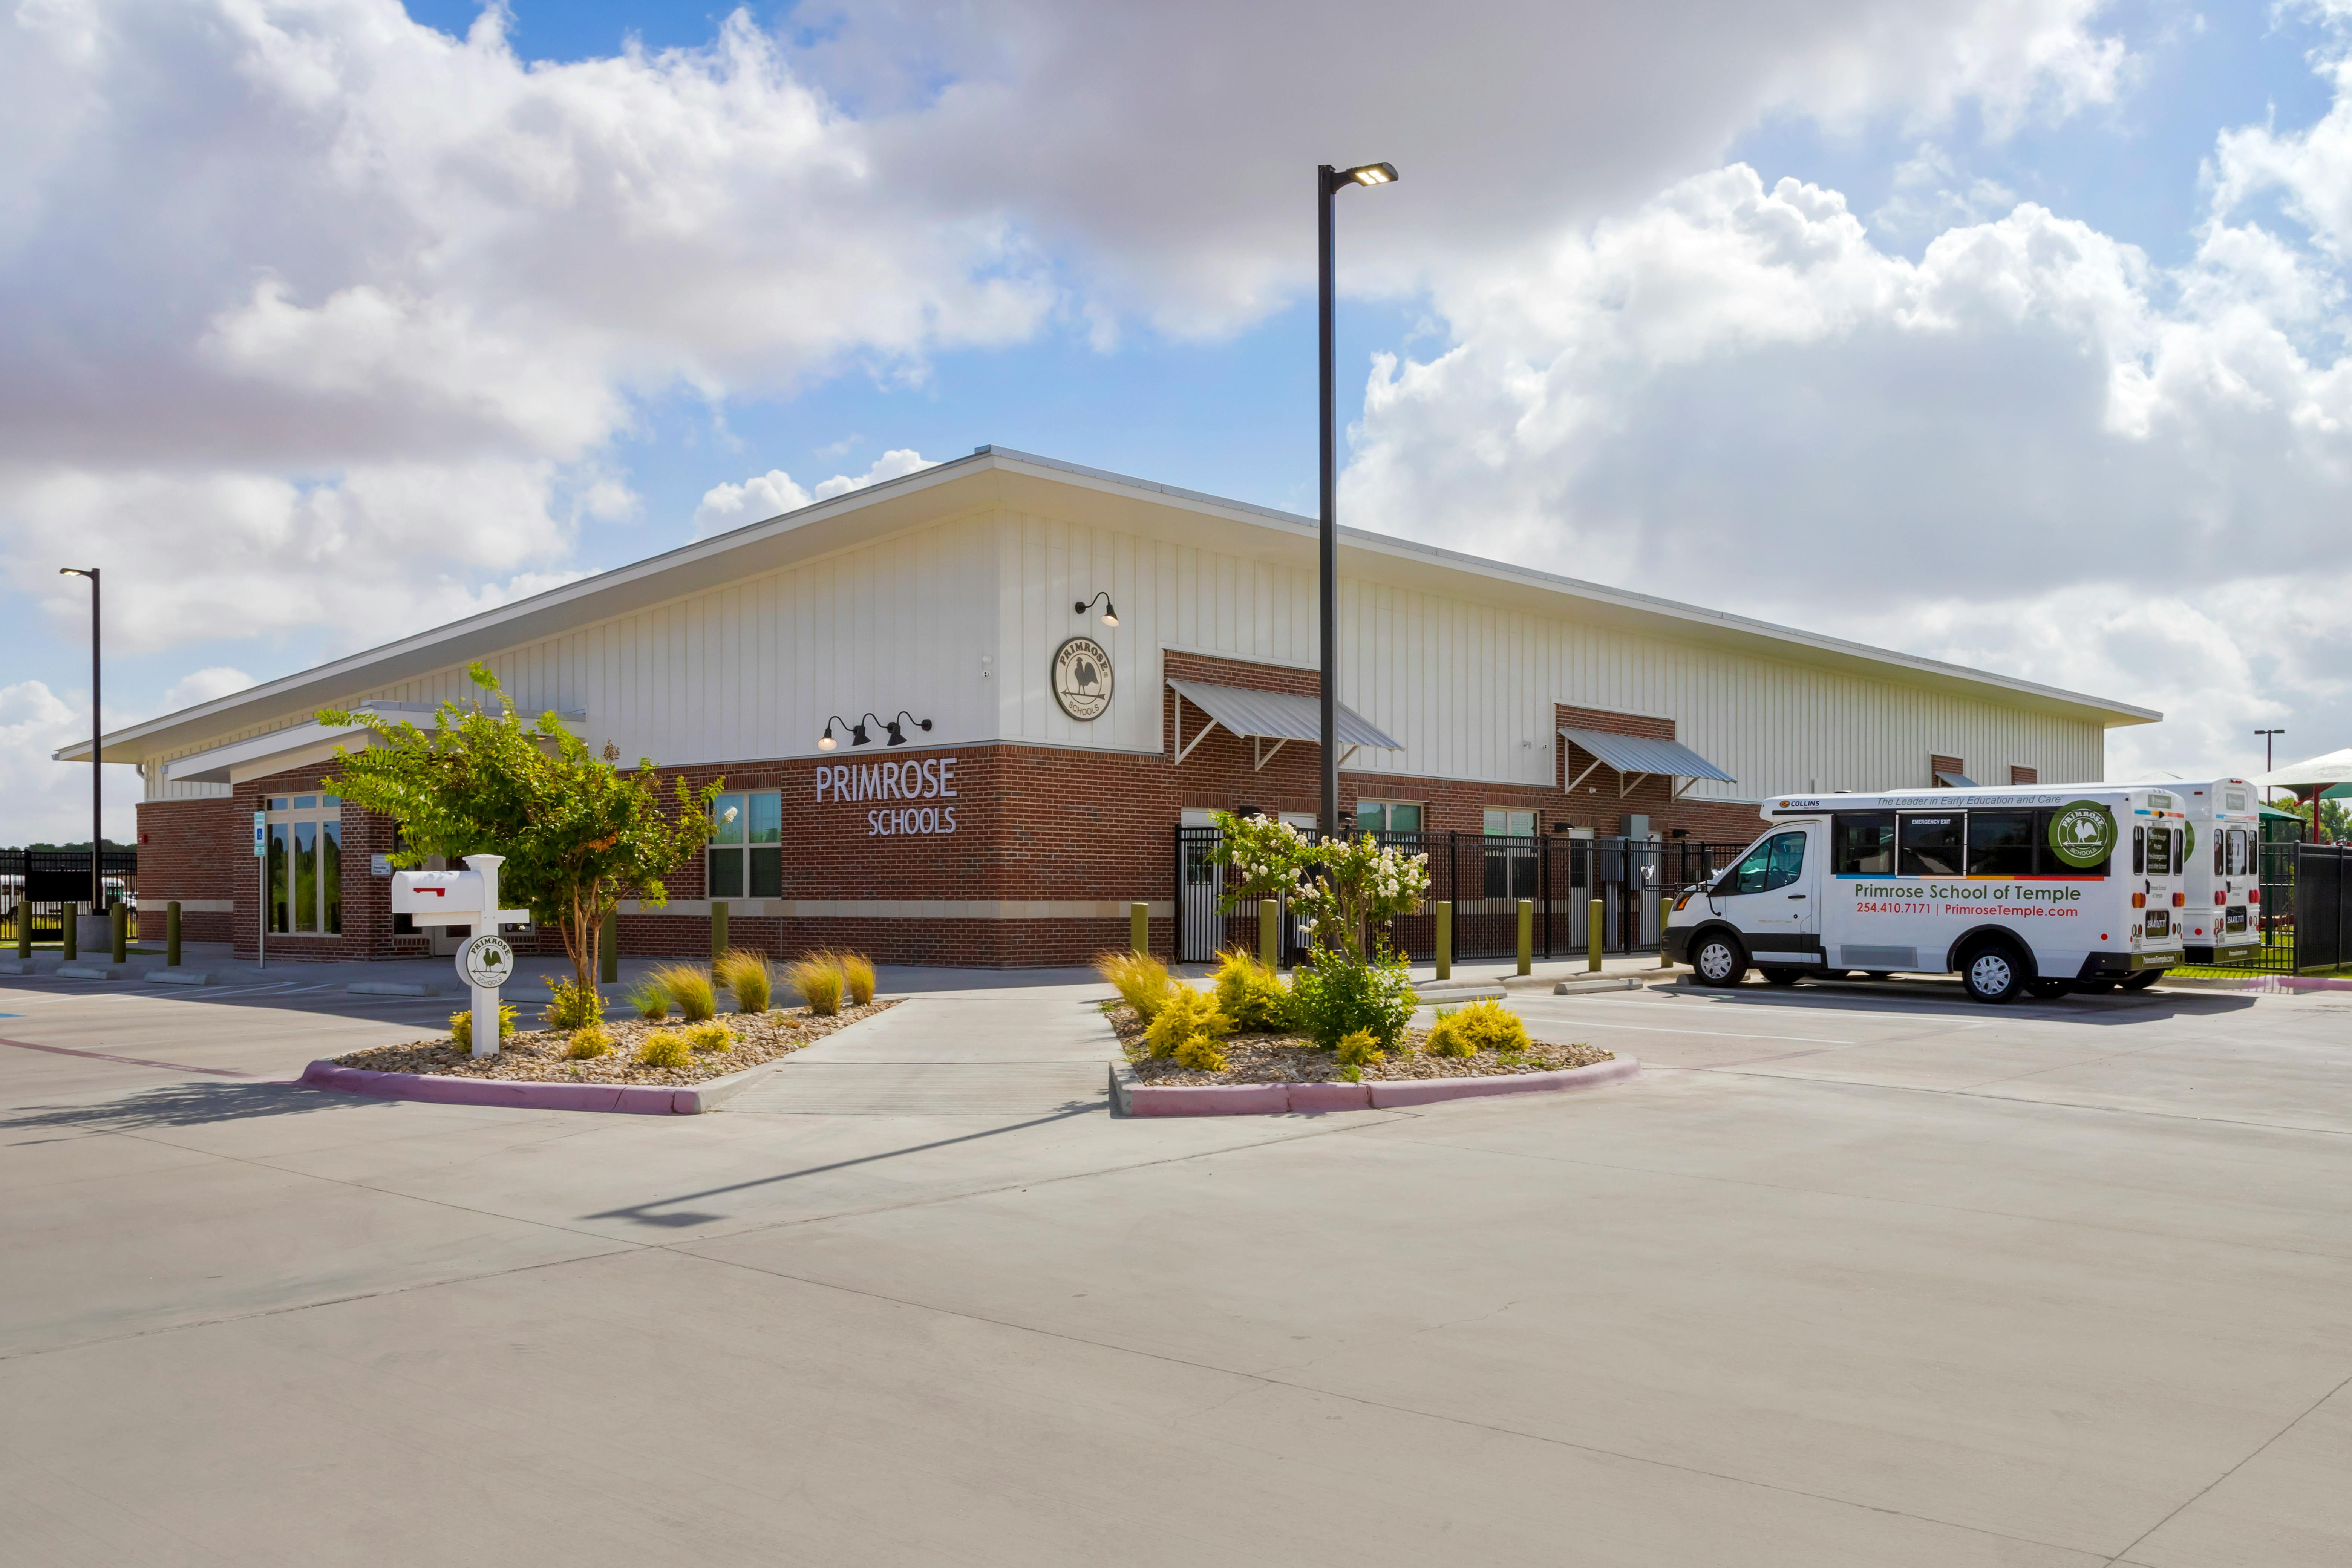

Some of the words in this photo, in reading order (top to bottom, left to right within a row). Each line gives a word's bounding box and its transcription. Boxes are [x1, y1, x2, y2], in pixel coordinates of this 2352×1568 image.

[1060, 642, 1108, 671] PRIMROSE
[1069, 701, 1099, 715] SCHOOLS
[816, 758, 958, 802] PRIMROSE
[1940, 796, 1965, 806] Early
[1967, 796, 2013, 804] Education
[2038, 795, 2061, 803] Care
[868, 807, 957, 836] SCHOOLS
[2062, 811, 2104, 828] PRIMROSE
[2070, 847, 2097, 856] SCHOOLS
[1855, 884, 1924, 898] Primrose
[1929, 884, 1987, 899] School
[1993, 885, 2010, 899] of
[2015, 886, 2081, 903] Temple
[1857, 902, 1931, 913] 254.410.7171
[1946, 904, 2078, 918] PrimroseTemple.com
[471, 938, 510, 956] PRIMROSE
[477, 976, 503, 986] SCHOOLS
